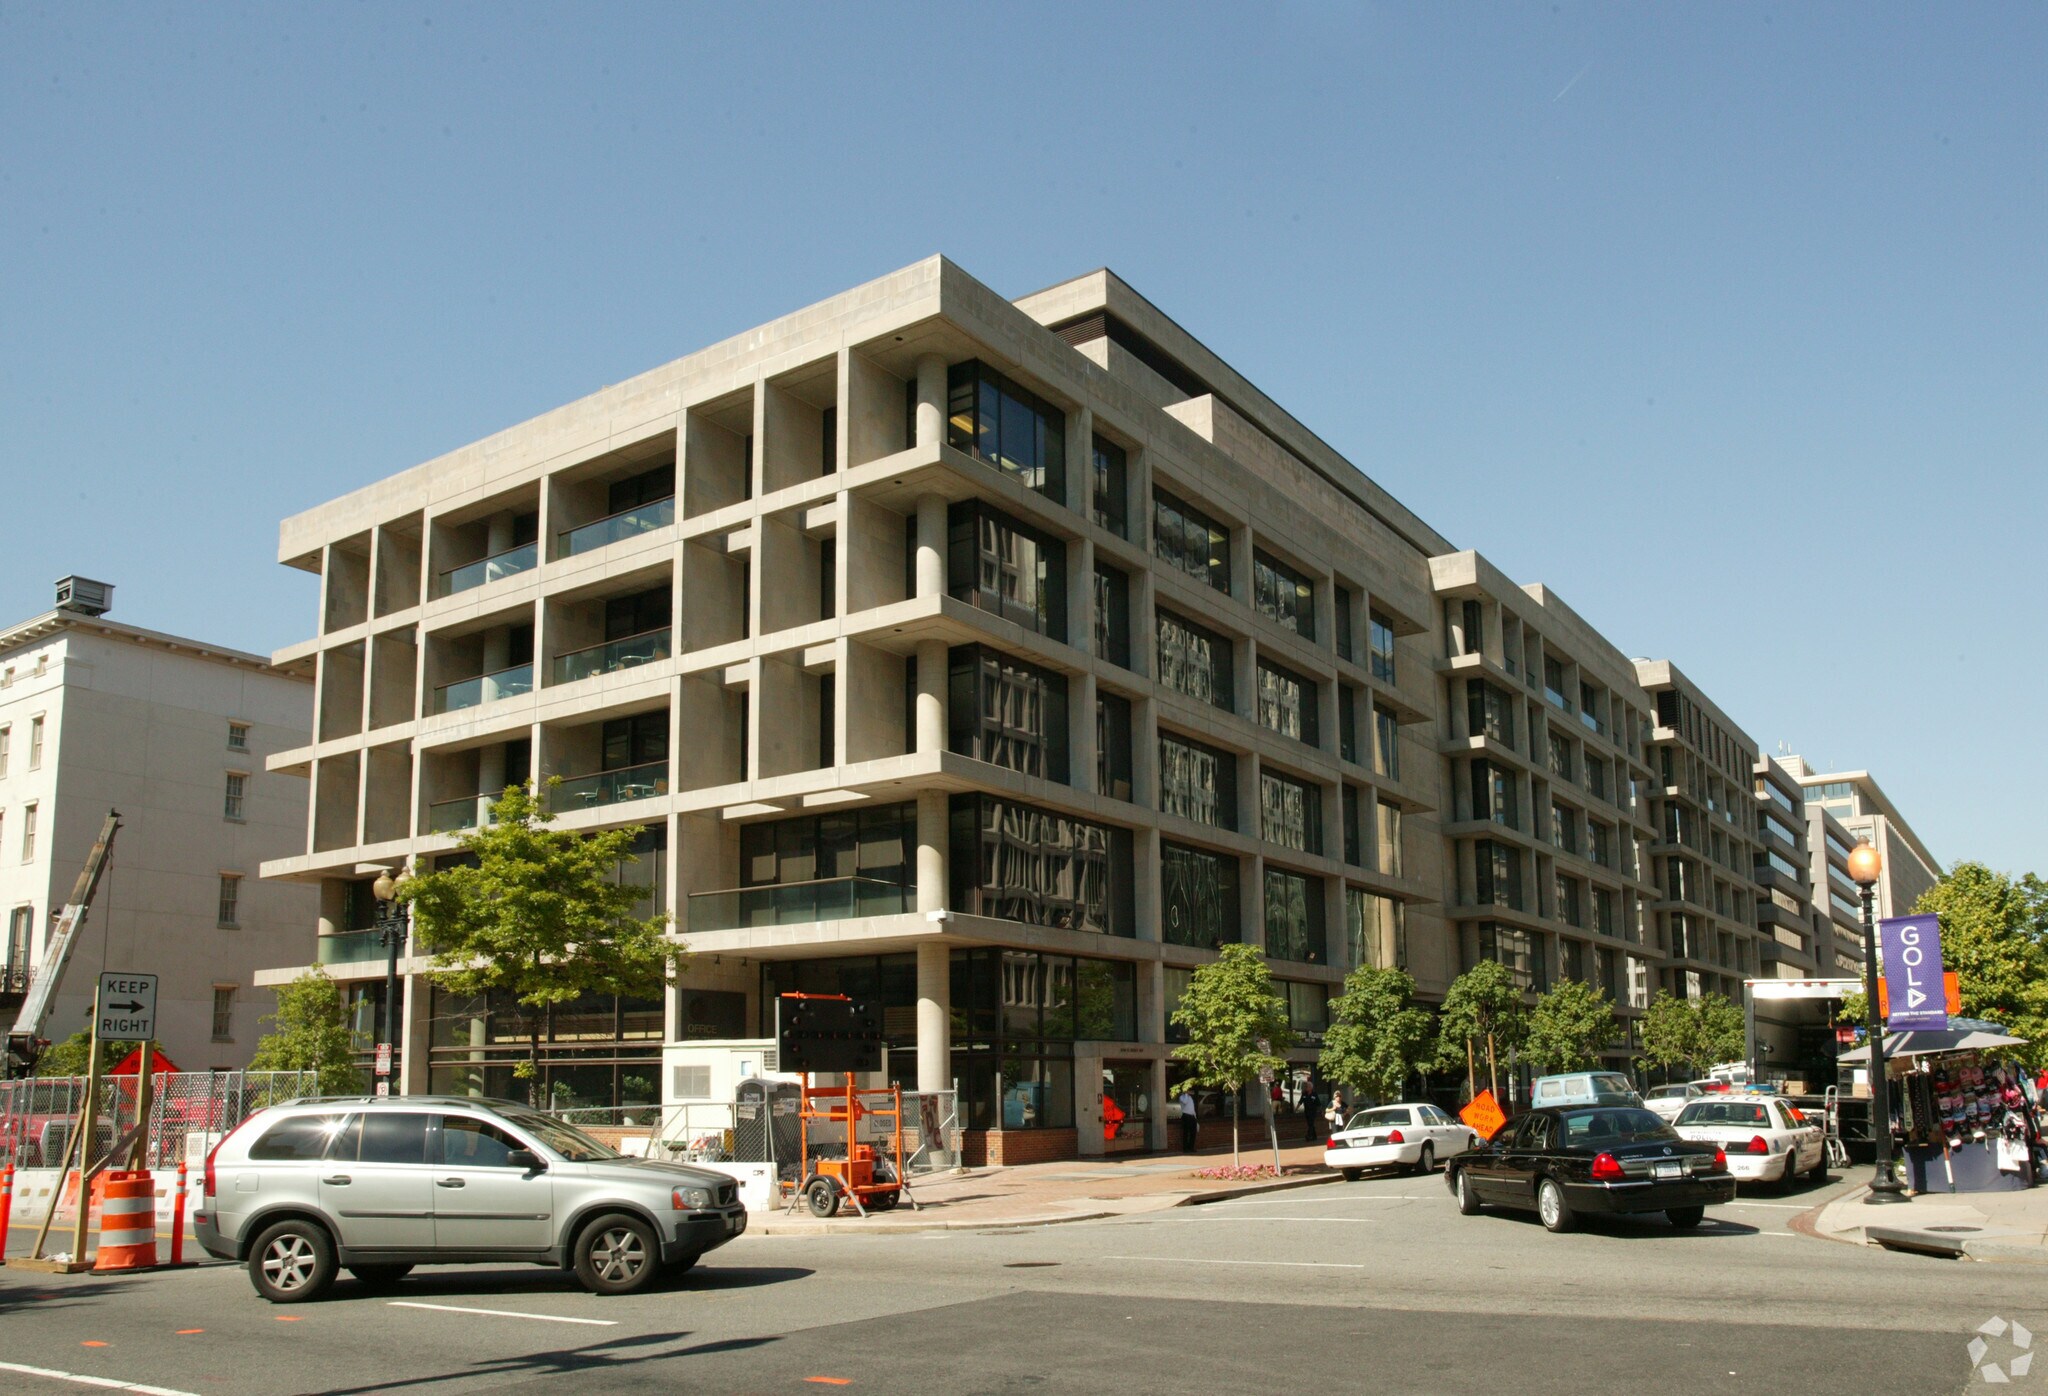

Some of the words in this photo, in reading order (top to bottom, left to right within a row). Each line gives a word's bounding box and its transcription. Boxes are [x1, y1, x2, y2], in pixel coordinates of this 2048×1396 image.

[1900, 925, 1927, 1009] GOLD
[107, 980, 150, 994] KEEP
[102, 1018, 150, 1033] RIGHT
[687, 1023, 718, 1034] OFFICE
[1476, 1102, 1495, 1113] ROAD
[1474, 1112, 1494, 1122] WORK
[1473, 1123, 1494, 1133] AHEAD
